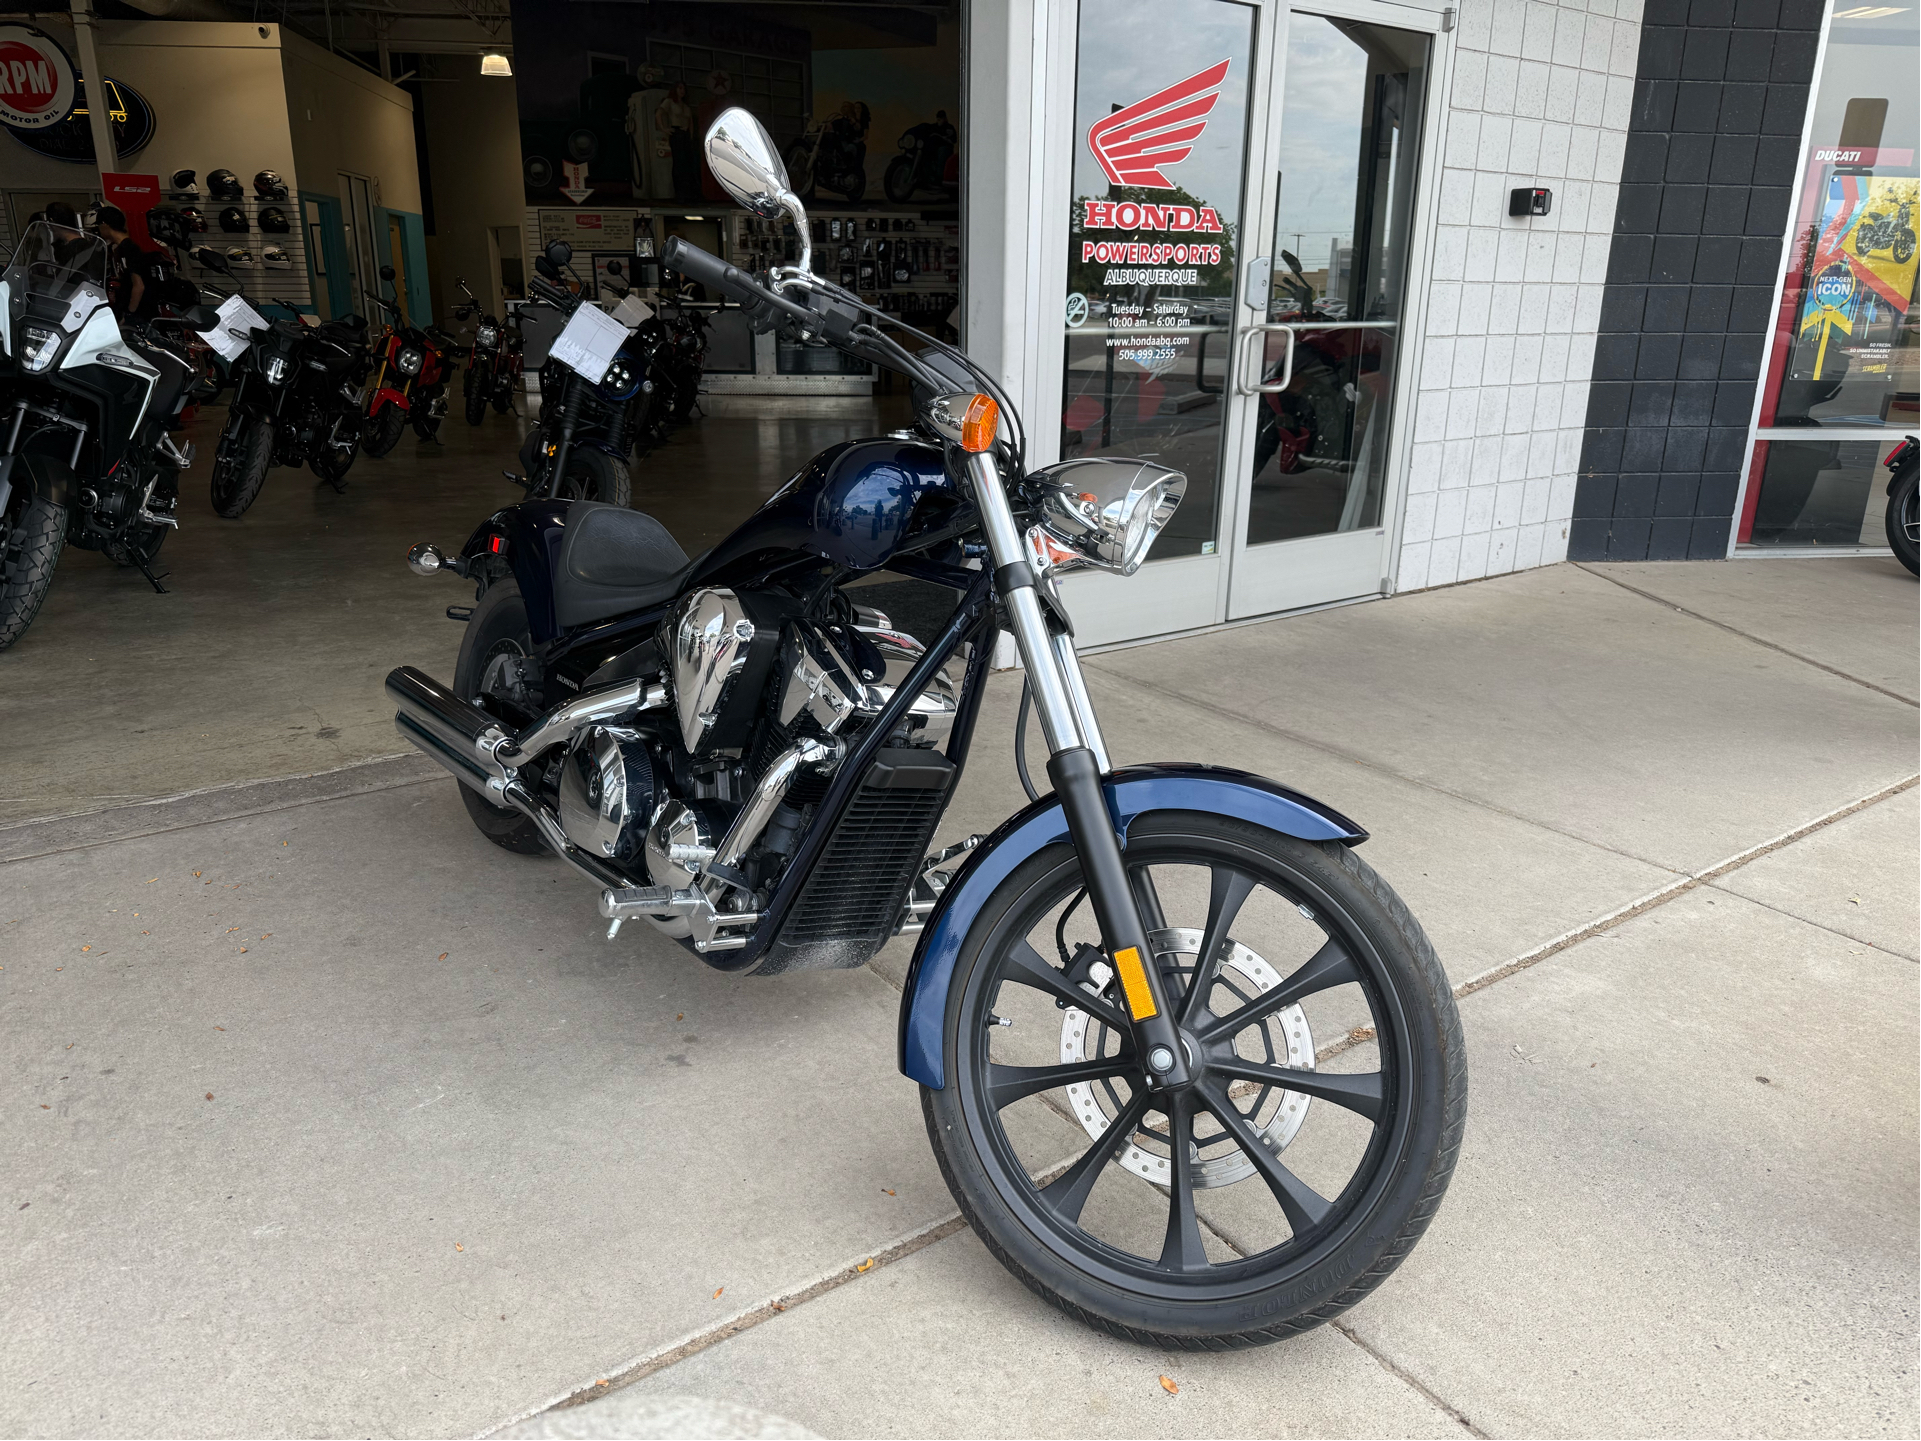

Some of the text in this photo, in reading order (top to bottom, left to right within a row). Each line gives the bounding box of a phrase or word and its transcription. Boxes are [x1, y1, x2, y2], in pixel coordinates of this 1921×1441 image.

[0, 60, 52, 94] RPM
[0, 109, 60, 124] MOTOR OIL
[1815, 150, 1862, 162] DUCATI
[1084, 200, 1223, 233] HONDA
[1082, 241, 1221, 265] POWERSPORTS
[1103, 269, 1198, 285] ALBUQUERQUE
[1820, 275, 1852, 283] NEXT-GEN
[1818, 284, 1851, 295] ICON
[1111, 304, 1144, 316] Tuesday
[1153, 304, 1189, 316] Saturday
[1108, 317, 1133, 327] 10:00
[1135, 319, 1148, 327] am
[1157, 317, 1176, 327] 6:00
[1177, 320, 1191, 329] pm
[1106, 336, 1190, 347] www.hondaabq.com
[1119, 349, 1176, 360] 505.999.2555
[556, 673, 580, 692] HONDA
[1237, 1253, 1354, 1322] DUNLOP
